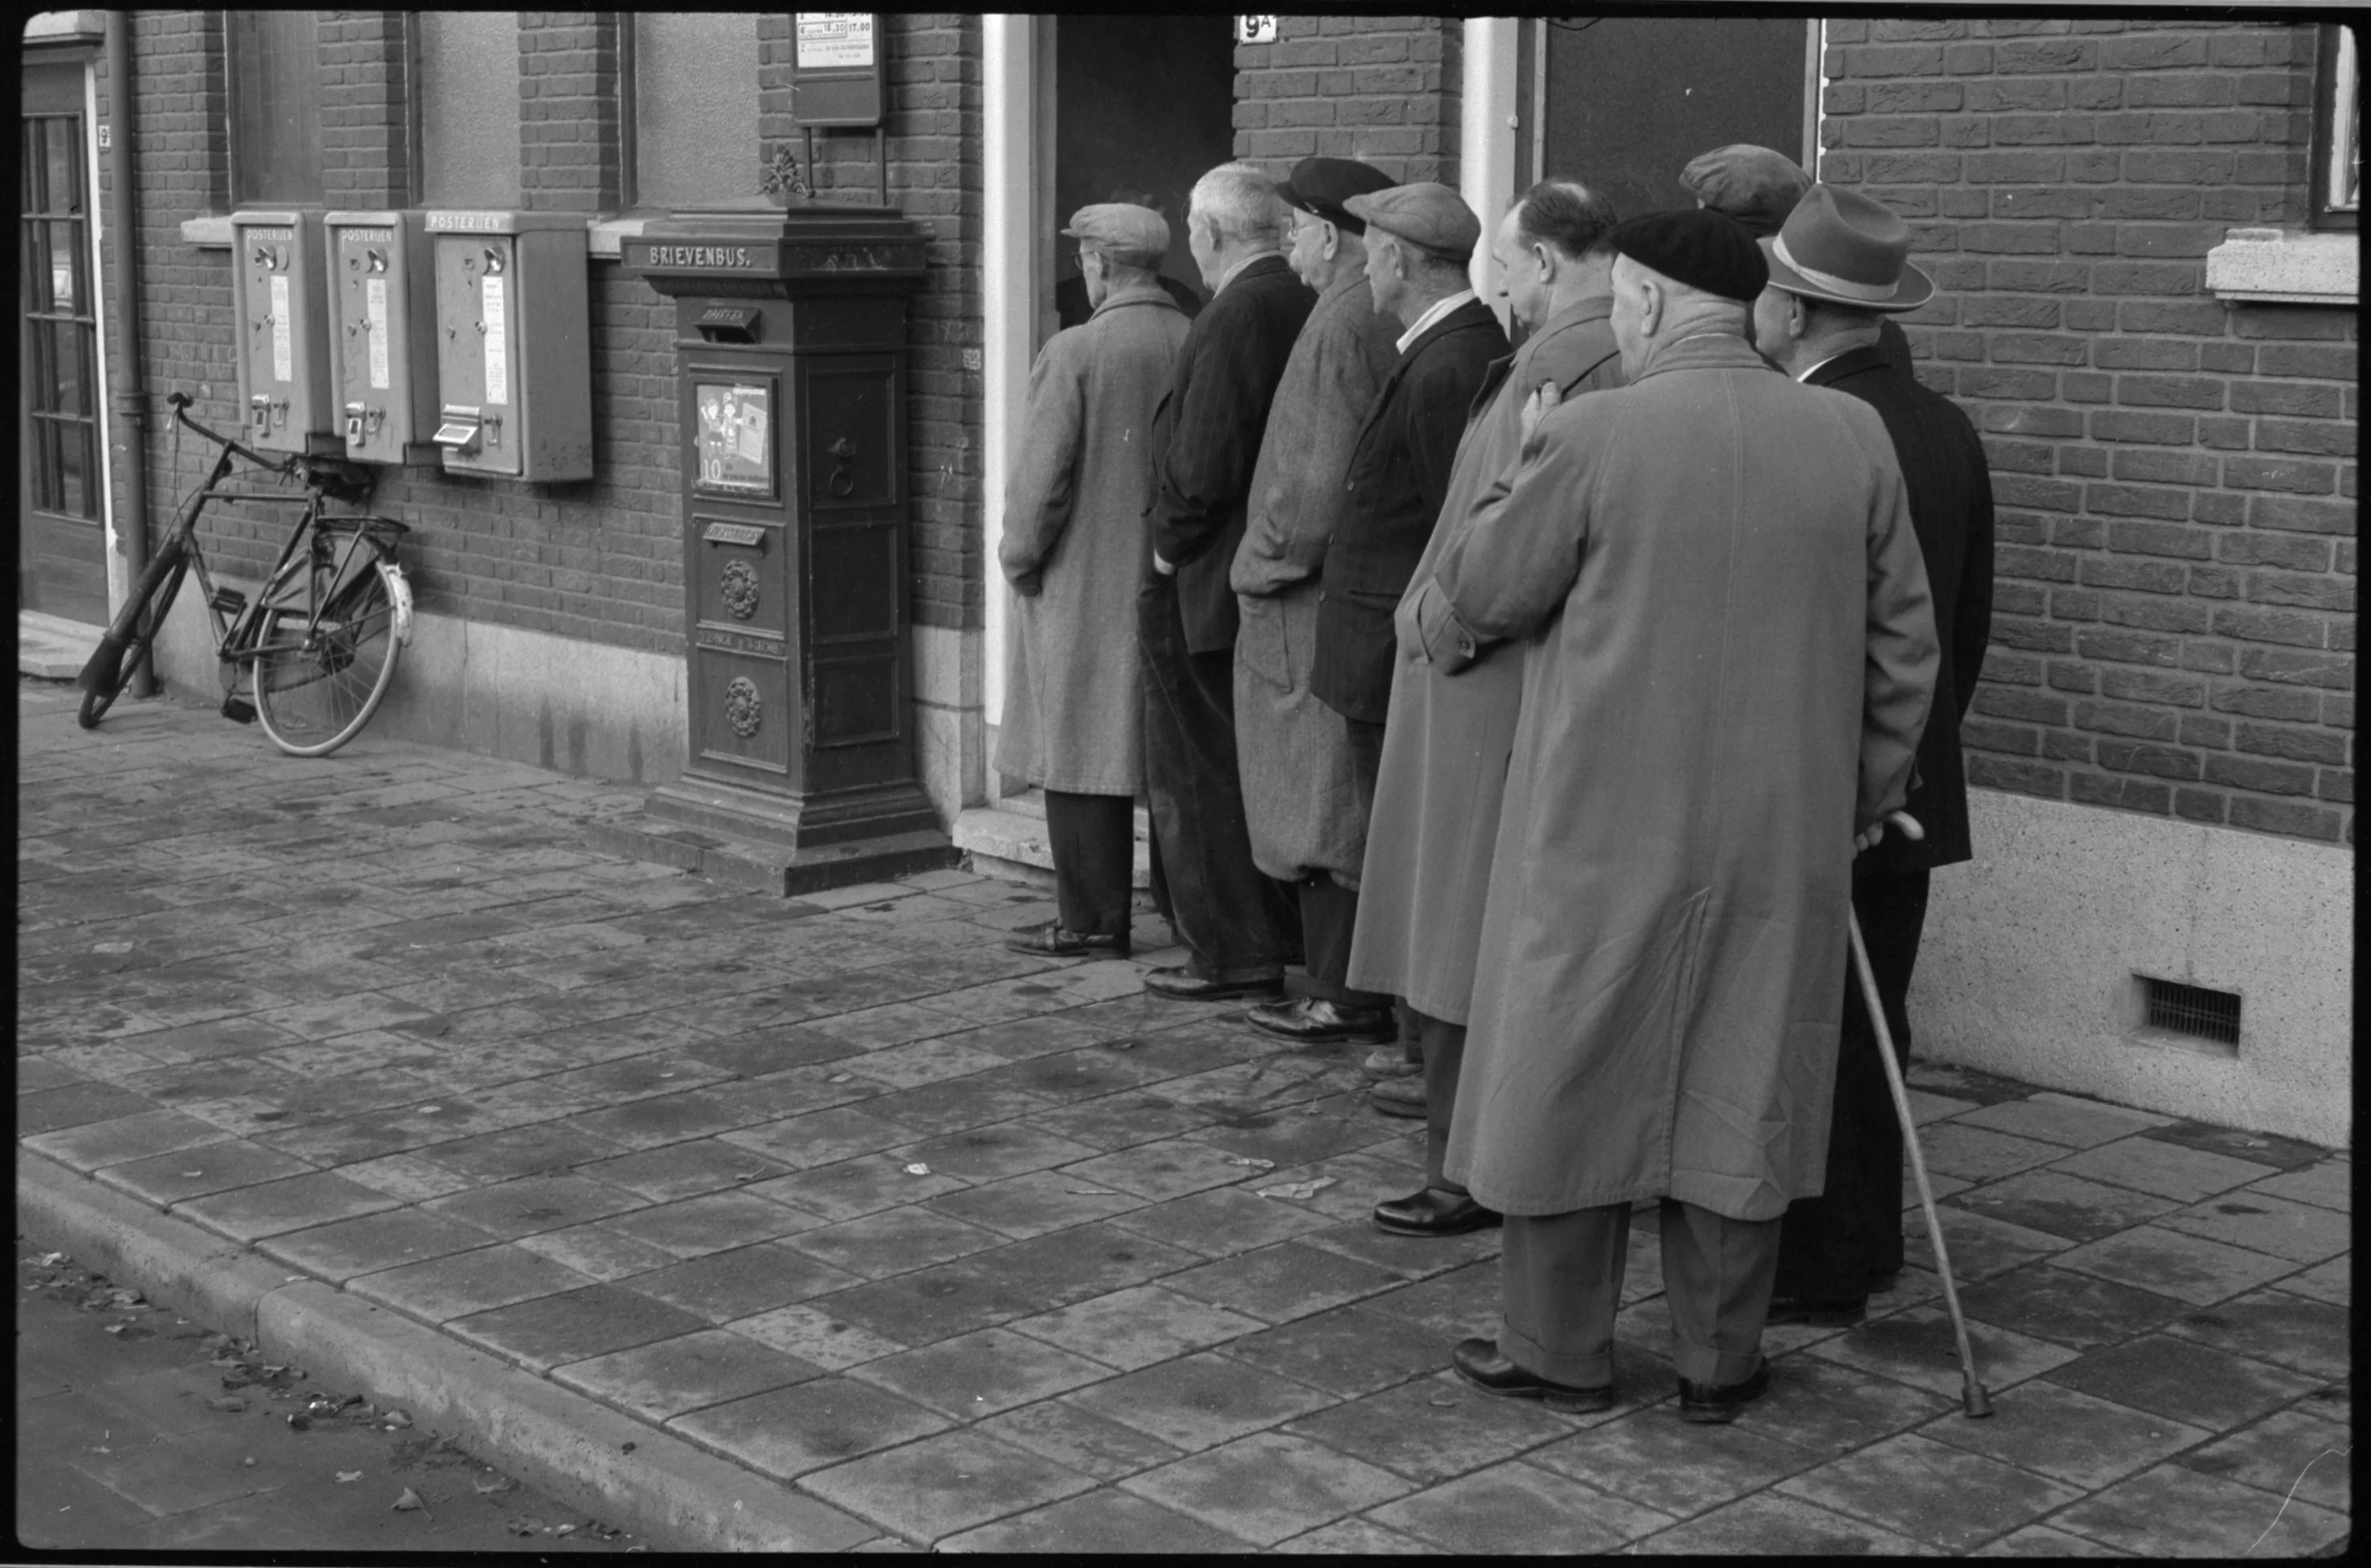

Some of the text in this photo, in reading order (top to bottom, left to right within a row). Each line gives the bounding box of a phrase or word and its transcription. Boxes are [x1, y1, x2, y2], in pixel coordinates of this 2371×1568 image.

[430, 215, 499, 230] POSTERIJEN
[650, 246, 751, 267] BRIEVENBUS.
[703, 458, 721, 479] 10
